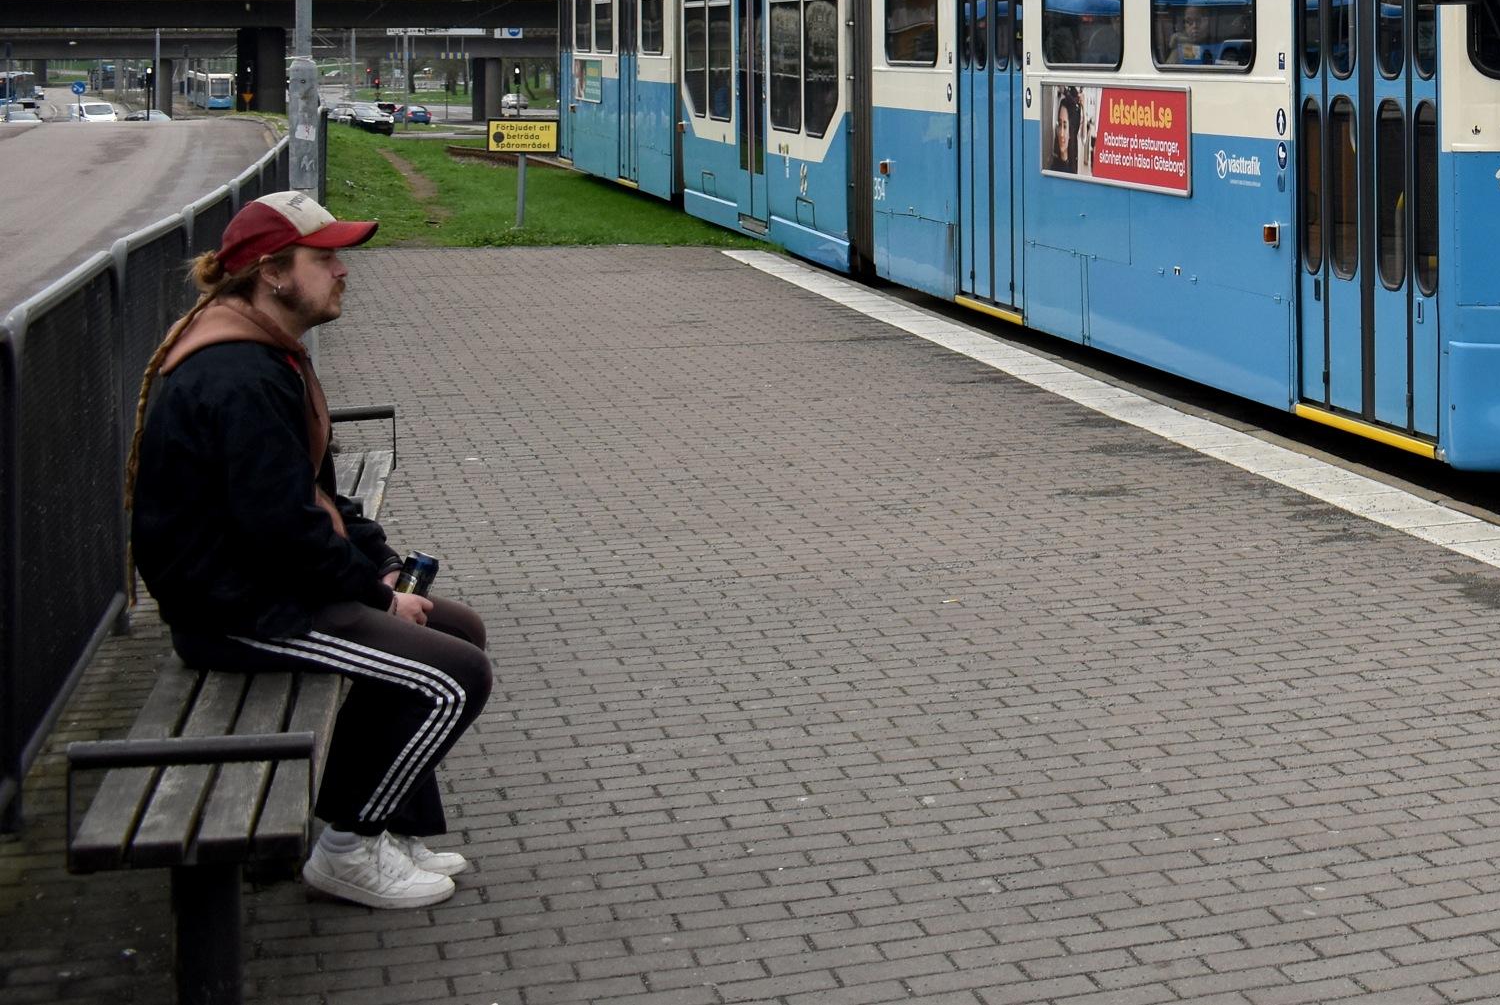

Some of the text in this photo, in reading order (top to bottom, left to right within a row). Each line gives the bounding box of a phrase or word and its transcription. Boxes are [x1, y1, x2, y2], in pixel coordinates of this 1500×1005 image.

[1109, 97, 1173, 129] letsdeal.se
[496, 123, 551, 132] Förbjudet att
[506, 132, 540, 140] beträda
[496, 141, 550, 149] spårområdet
[1104, 131, 1180, 157] Rabatter på restauranger,
[1099, 149, 1122, 165] skönhet
[1122, 152, 1134, 167] och
[1134, 153, 1151, 170] hälsa
[1154, 156, 1186, 177] Göteborg!
[1228, 154, 1261, 175] västtrafik
